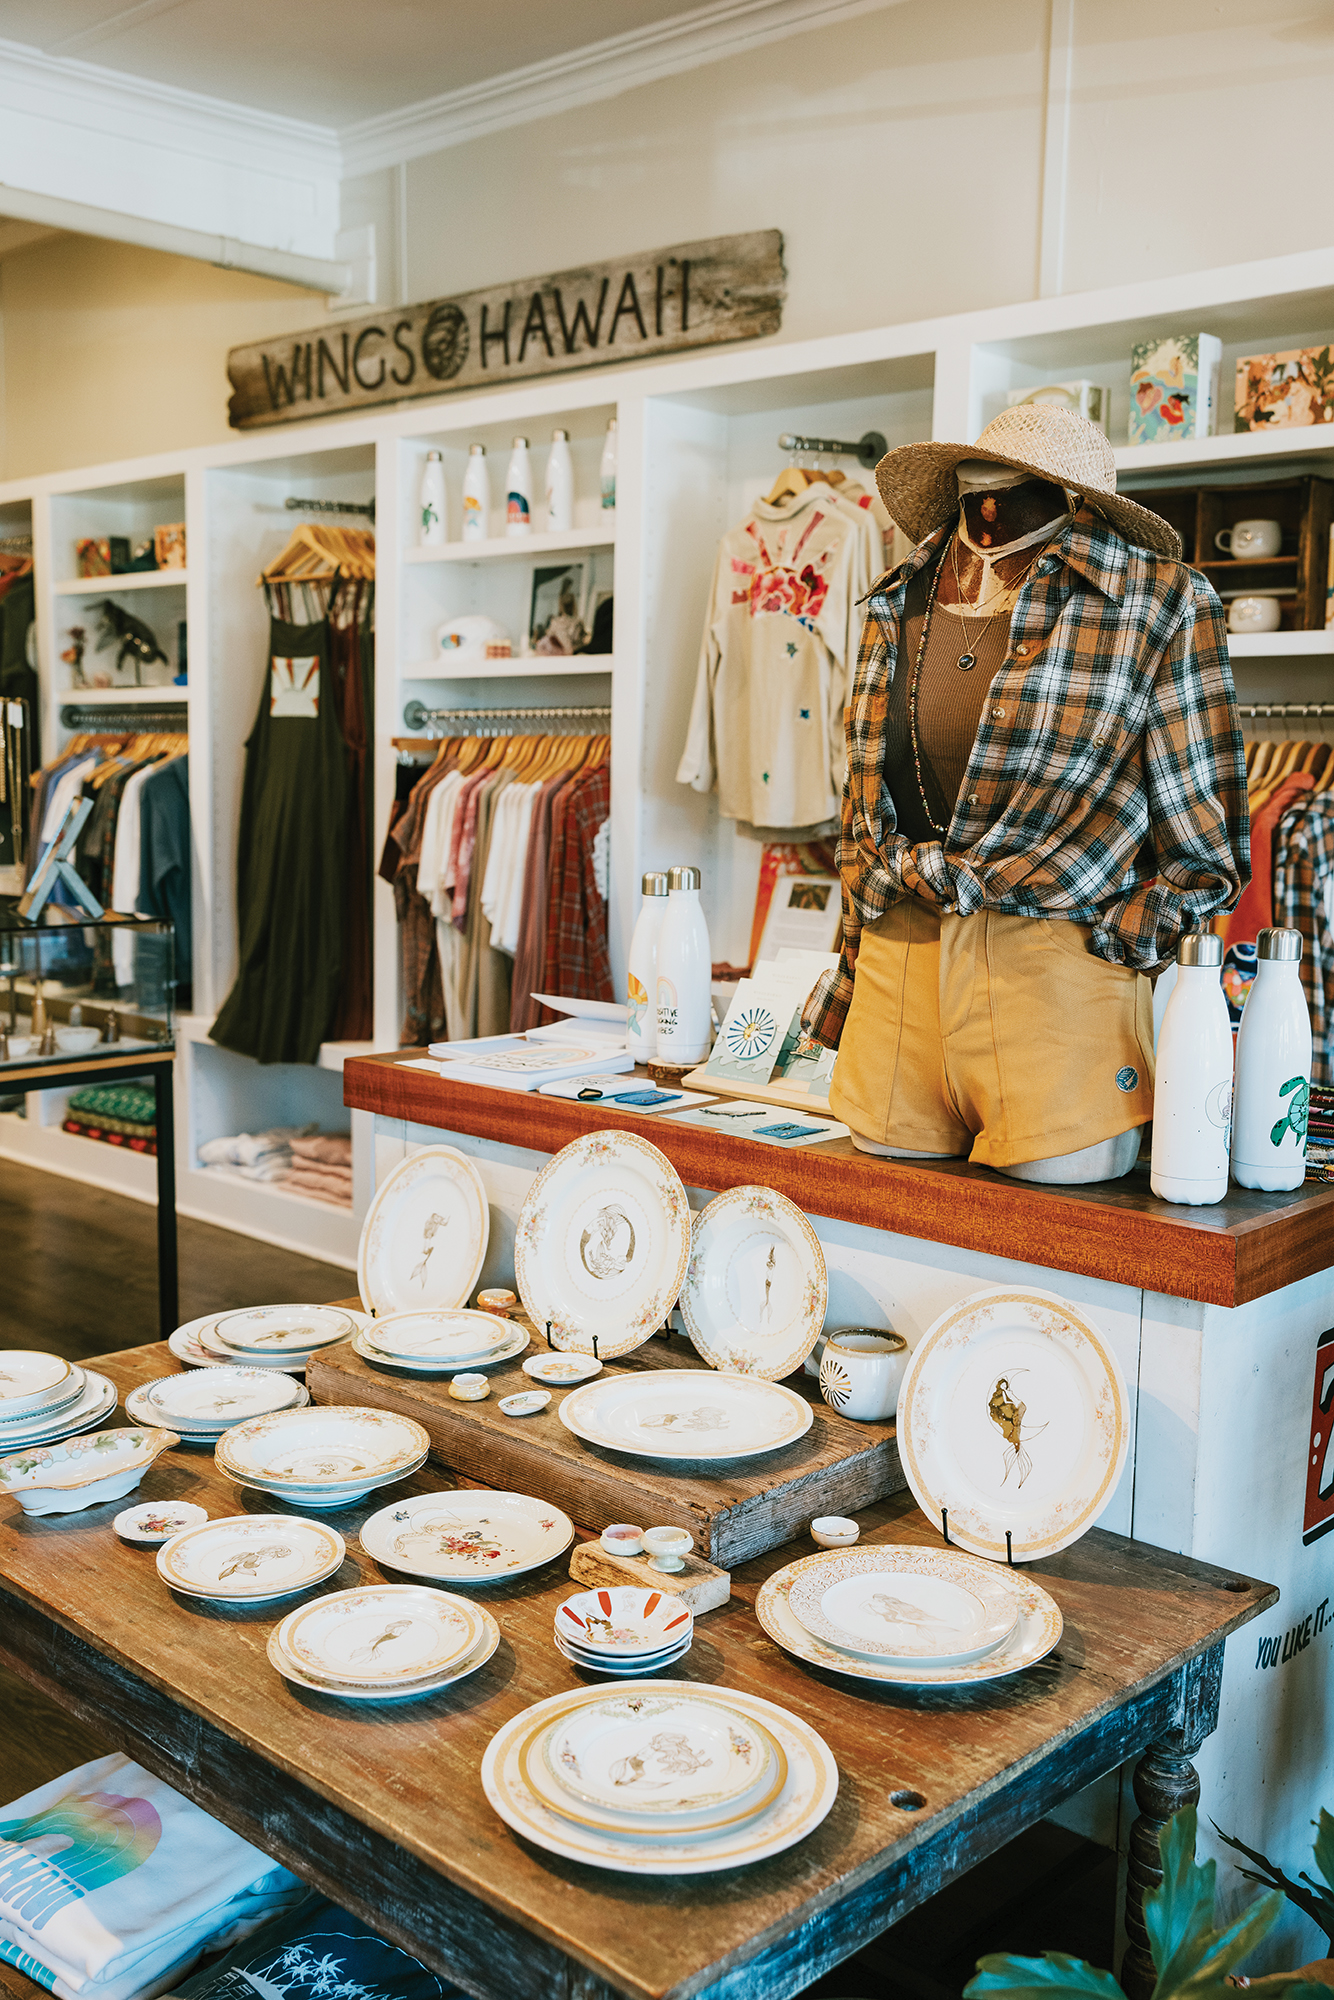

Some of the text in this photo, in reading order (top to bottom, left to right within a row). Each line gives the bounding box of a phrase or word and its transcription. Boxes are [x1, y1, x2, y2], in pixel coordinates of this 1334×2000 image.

[261, 258, 691, 410] WINGS HAWAII
[1255, 1635, 1282, 1669] YOU
[1282, 1613, 1313, 1664] LIKE
